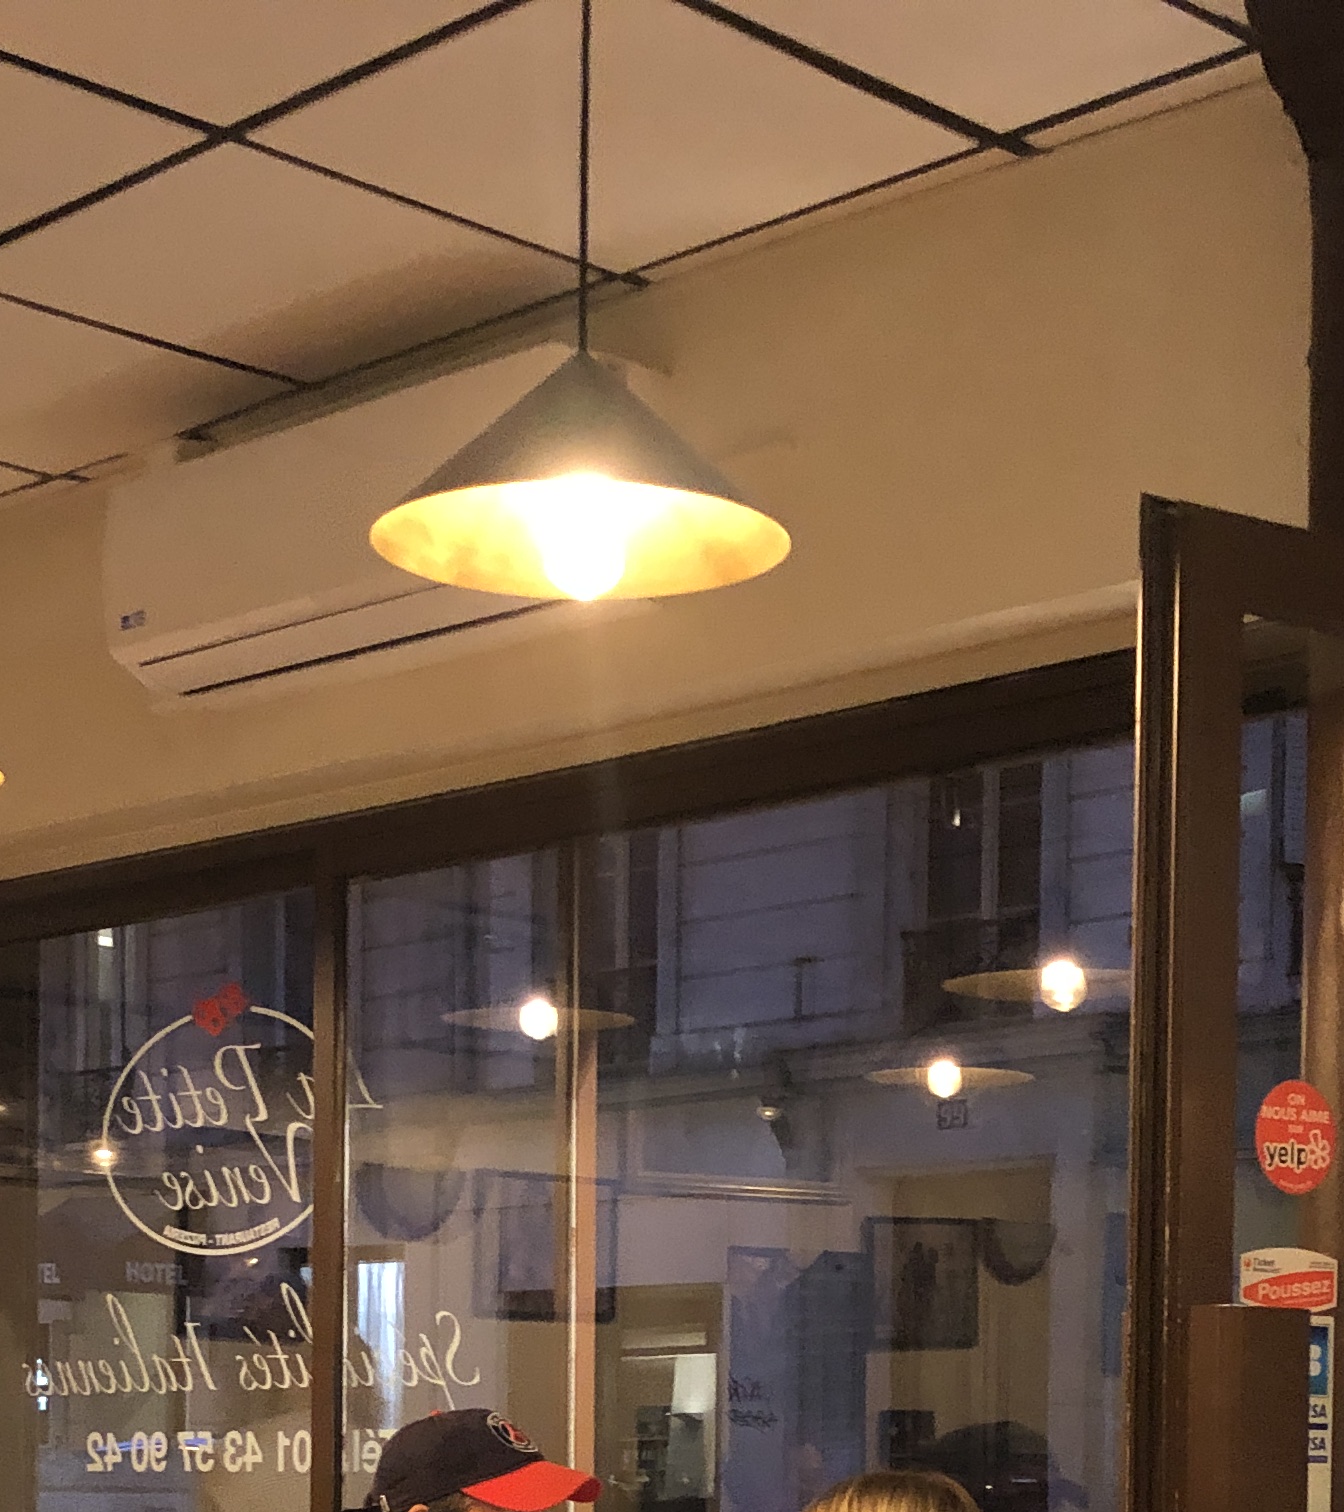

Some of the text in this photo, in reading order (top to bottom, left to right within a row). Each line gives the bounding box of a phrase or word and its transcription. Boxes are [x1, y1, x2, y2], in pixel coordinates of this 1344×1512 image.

[1260, 1105, 1297, 1120] NOUS
[1265, 1140, 1308, 1170] yelp
[126, 1261, 189, 1285] HOTEL
[1258, 1280, 1332, 1300] Poussez
